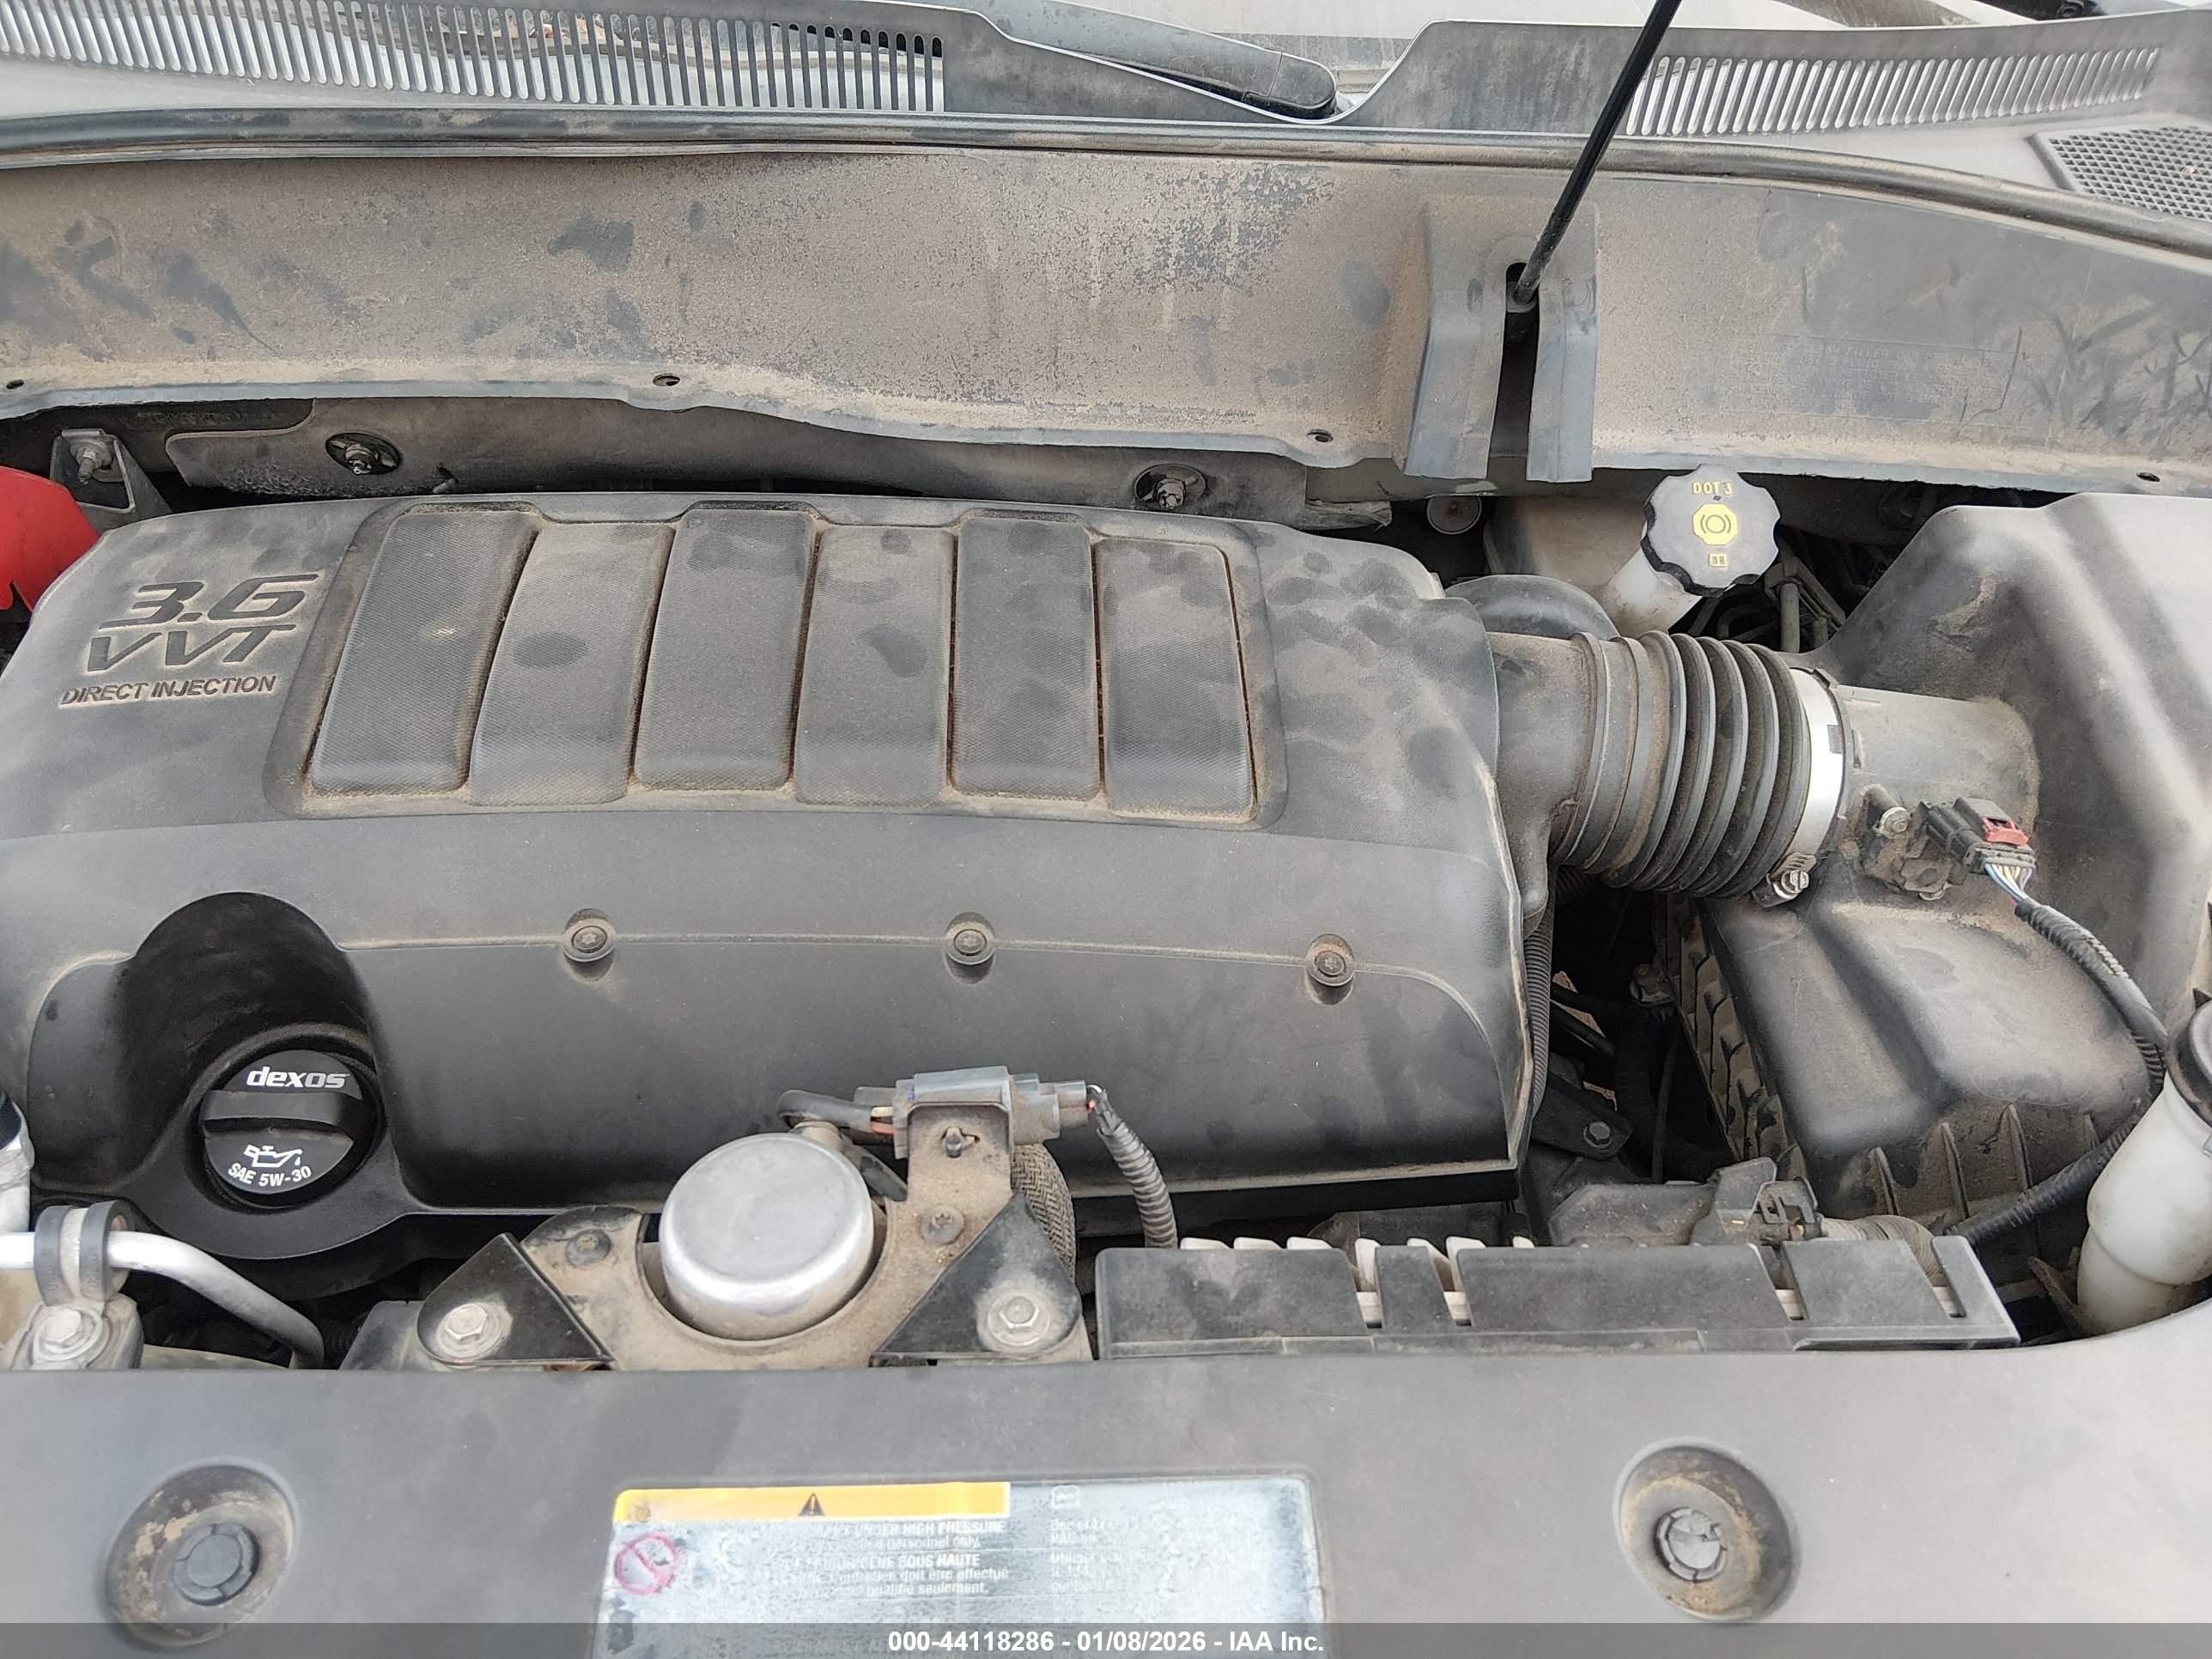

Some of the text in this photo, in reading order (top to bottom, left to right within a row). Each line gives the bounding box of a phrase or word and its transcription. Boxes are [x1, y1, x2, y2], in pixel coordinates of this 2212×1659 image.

[1692, 481, 1733, 495] DOT 3
[98, 574, 319, 629] 3.6
[87, 624, 296, 672] VVT
[61, 675, 277, 705] DIRECT INJECTION
[246, 1066, 349, 1089] dexos
[228, 1162, 312, 1187] SAE 5W-30
[902, 1522, 934, 1536] HIGH
[937, 1520, 1005, 1534] PRESSURE
[898, 1554, 934, 1568] SOUS
[936, 1553, 981, 1566] HAUTE
[900, 1567, 927, 1582] doit
[918, 1581, 989, 1595] seulement.
